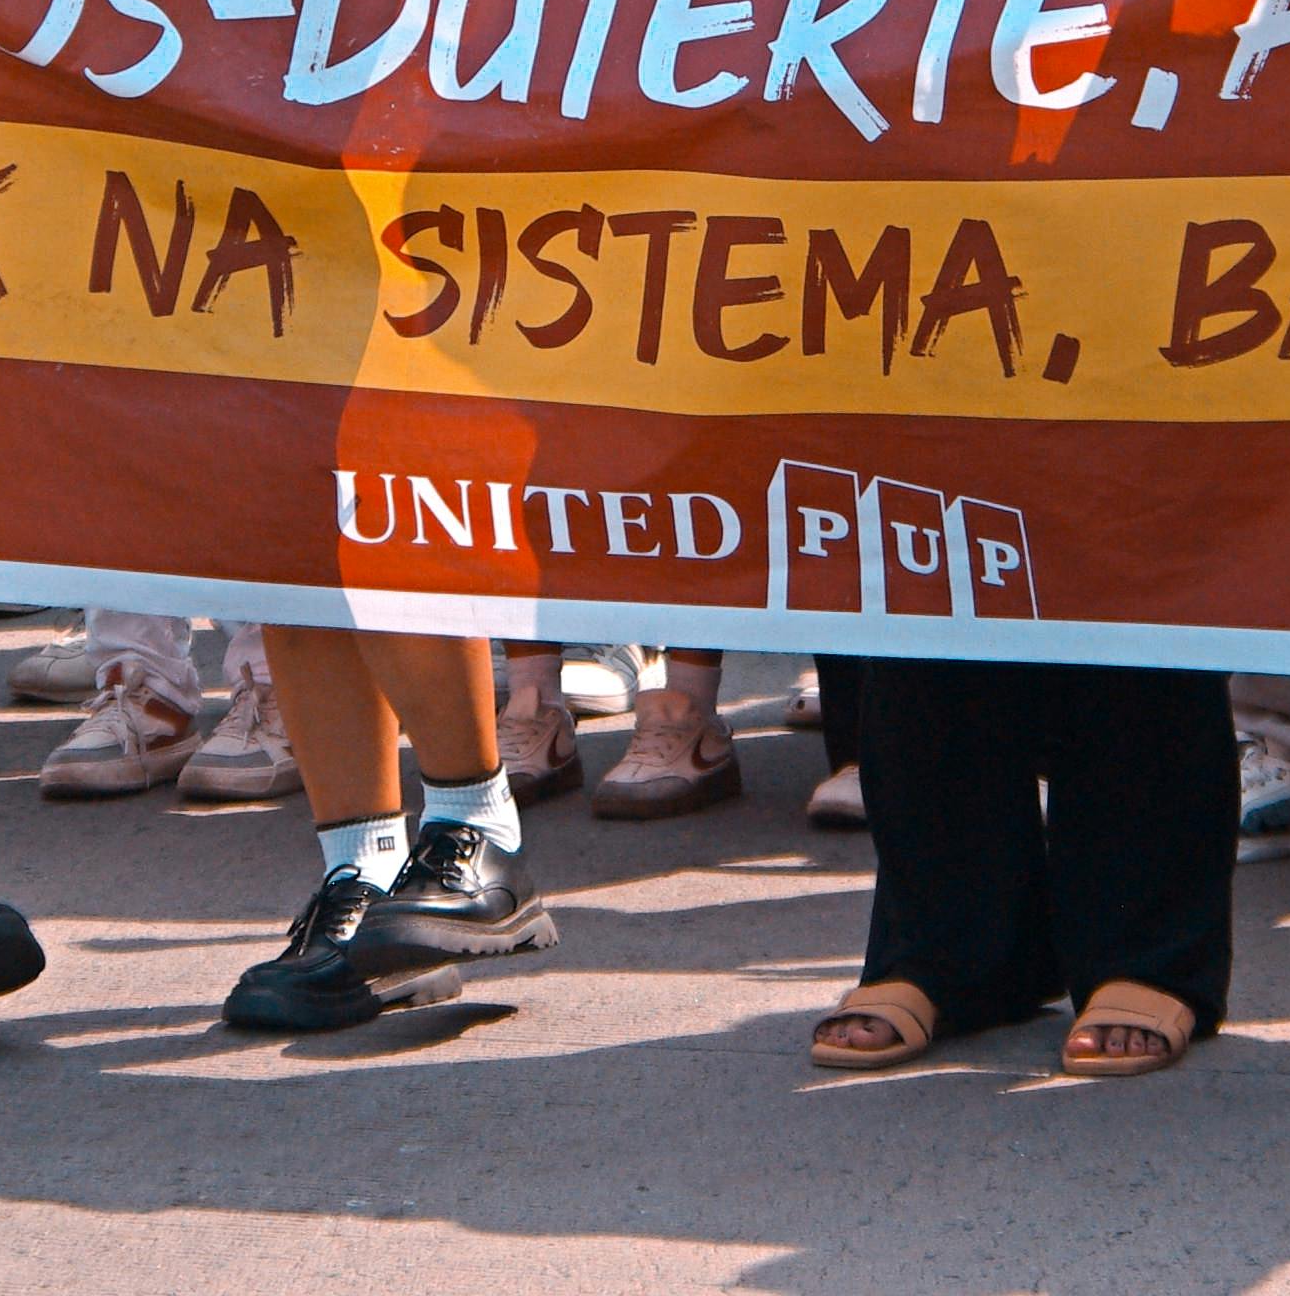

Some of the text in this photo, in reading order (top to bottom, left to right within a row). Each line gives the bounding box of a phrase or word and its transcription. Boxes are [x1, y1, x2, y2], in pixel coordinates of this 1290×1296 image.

[89, 170, 301, 338] NA
[382, 203, 1081, 385] SISTEMA,
[332, 470, 742, 561] UNITED
